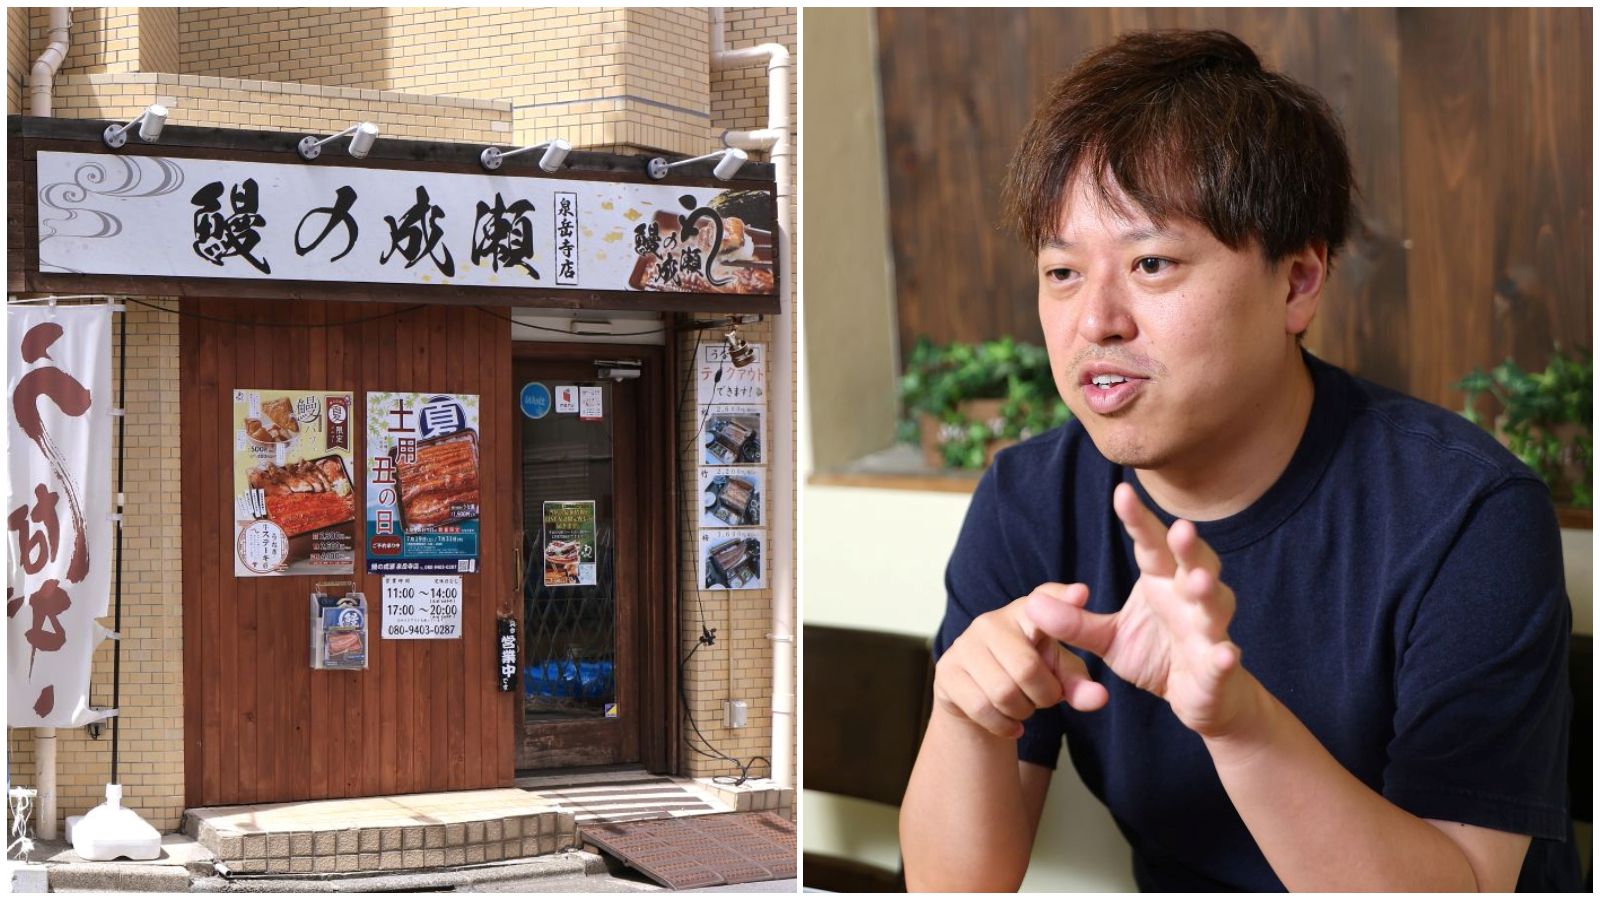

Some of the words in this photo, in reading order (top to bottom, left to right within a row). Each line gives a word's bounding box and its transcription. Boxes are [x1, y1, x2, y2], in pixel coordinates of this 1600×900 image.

[191, 178, 540, 280] 鰻の成瀬
[557, 197, 576, 278] 泉岳寺店
[701, 367, 764, 381] テクアウト
[421, 399, 460, 441] 夏
[387, 588, 415, 598] 11:00
[387, 605, 415, 615] 17:00
[388, 625, 456, 635] 080-9403-0287
[501, 635, 516, 678] 営業中
